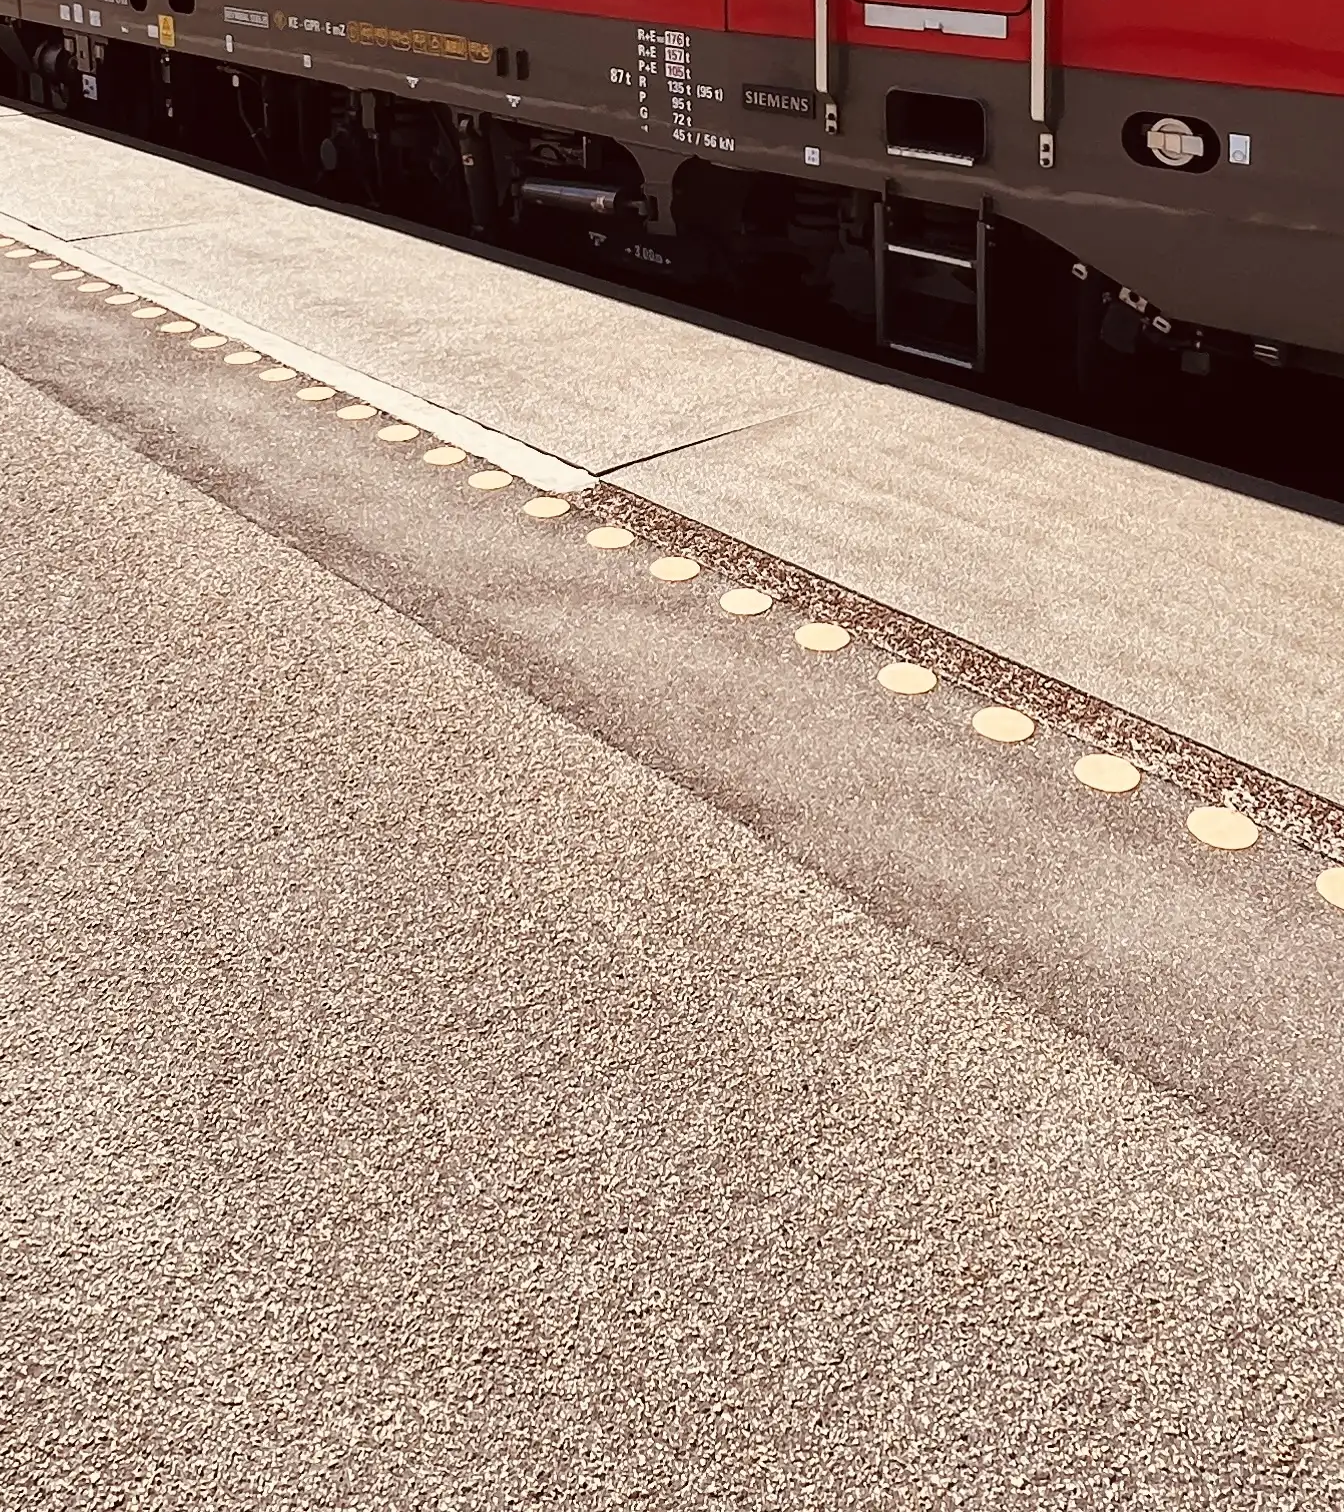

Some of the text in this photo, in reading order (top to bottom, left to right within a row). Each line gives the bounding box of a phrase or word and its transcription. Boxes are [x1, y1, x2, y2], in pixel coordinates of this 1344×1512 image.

[666, 32, 684, 46] 176
[685, 35, 691, 48] t
[637, 44, 691, 64] R+E 157 t
[610, 68, 625, 84] 87
[638, 60, 692, 80] P+E 105 t
[638, 75, 647, 88] R
[667, 81, 685, 95] 135
[686, 83, 692, 96] t
[696, 85, 713, 101] (95
[639, 91, 692, 112] P 95 t
[745, 90, 809, 112] SIEMENS
[639, 107, 692, 128] G 72 t
[672, 128, 686, 142] 45
[686, 131, 693, 144] t
[704, 134, 717, 149] 56
[719, 137, 735, 152] kN
